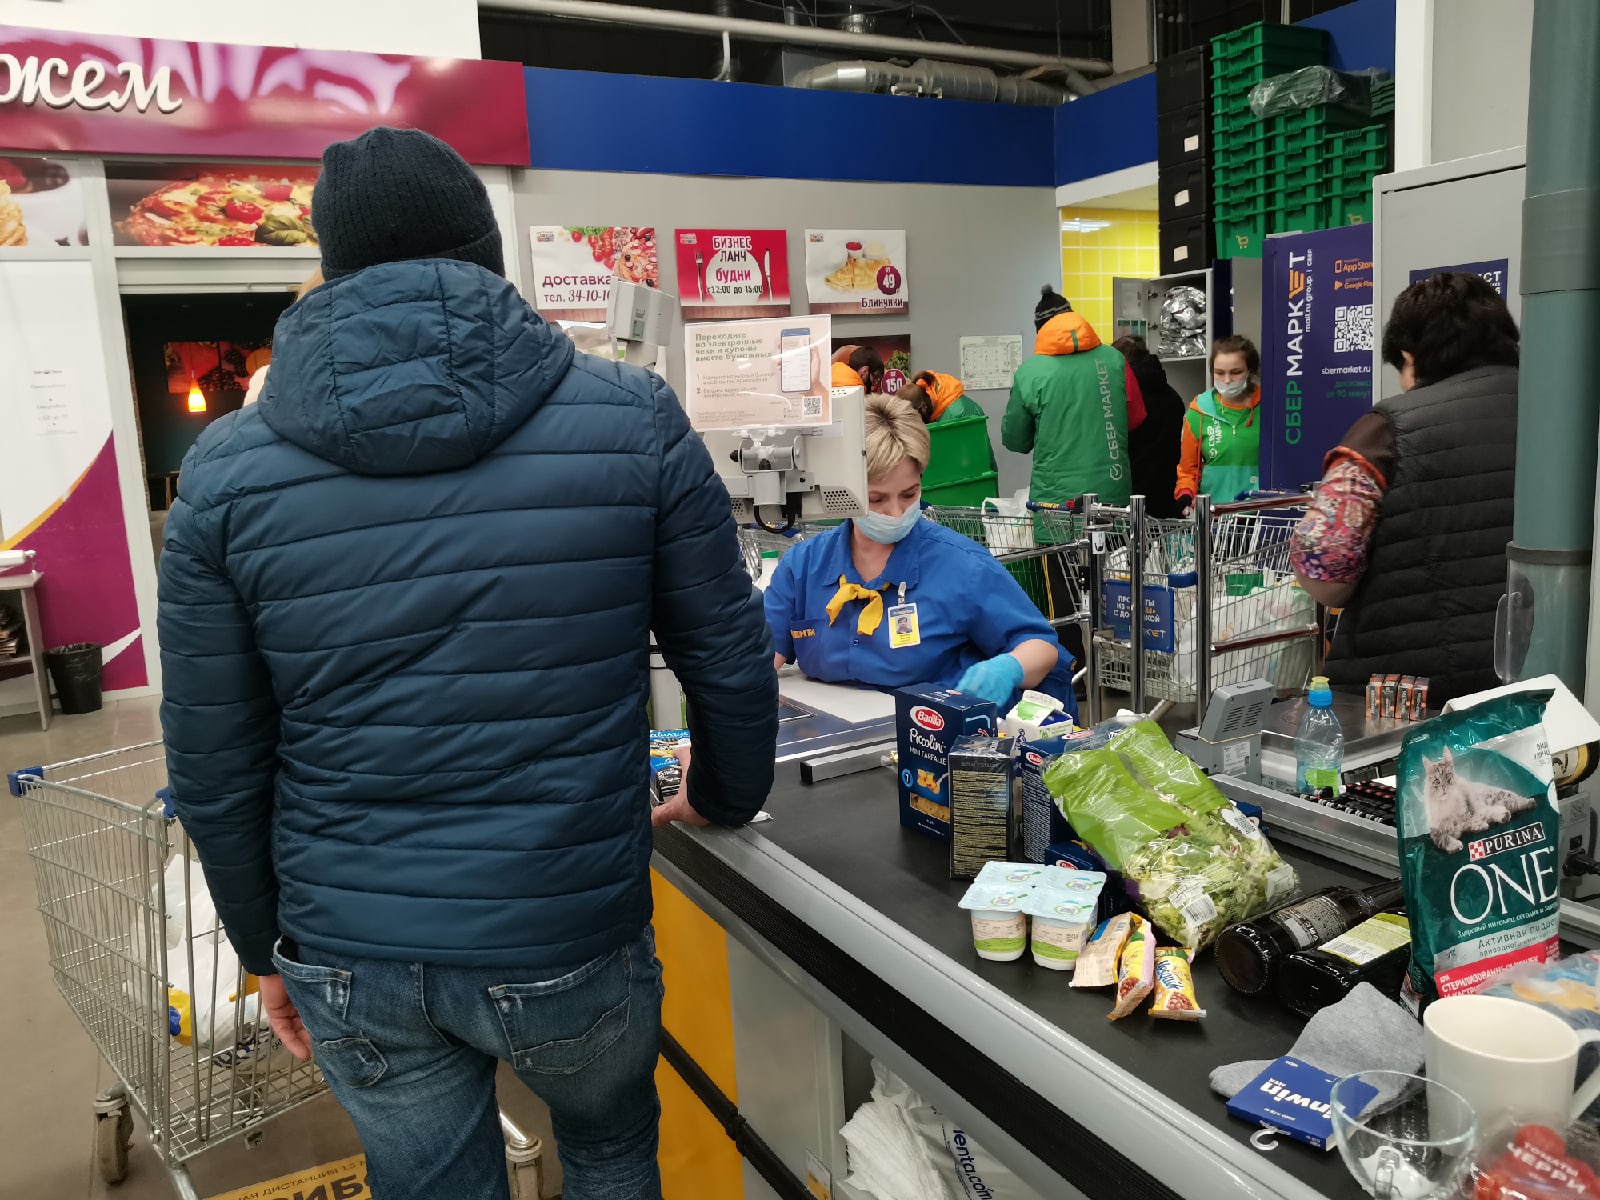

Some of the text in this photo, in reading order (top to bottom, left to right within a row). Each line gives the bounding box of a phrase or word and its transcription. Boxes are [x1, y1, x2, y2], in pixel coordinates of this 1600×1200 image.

[712, 237, 751, 249] БИЗНЕС
[719, 250, 747, 262] ЛАНЧ
[715, 267, 751, 283] будни
[1343, 263, 1358, 272] App
[542, 275, 611, 288] доставка
[882, 273, 895, 289] 49
[1306, 276, 1314, 302] group
[543, 293, 565, 302] тел.
[711, 285, 731, 294] 12:00
[733, 286, 743, 294] до
[745, 285, 763, 294] 15:00
[861, 298, 903, 308] Блинчики
[1321, 366, 1371, 375] sbermarket.ru
[885, 378, 902, 393] 150
[917, 710, 943, 727] Barilla
[909, 727, 946, 754] Piccolini
[1485, 827, 1541, 855] PURINA
[1450, 846, 1558, 924] ONE
[953, 1129, 993, 1200] lenta.com
[1524, 1141, 1579, 1178] ТОМАТЫ
[1506, 1141, 1587, 1195] ЧЕРРИ
